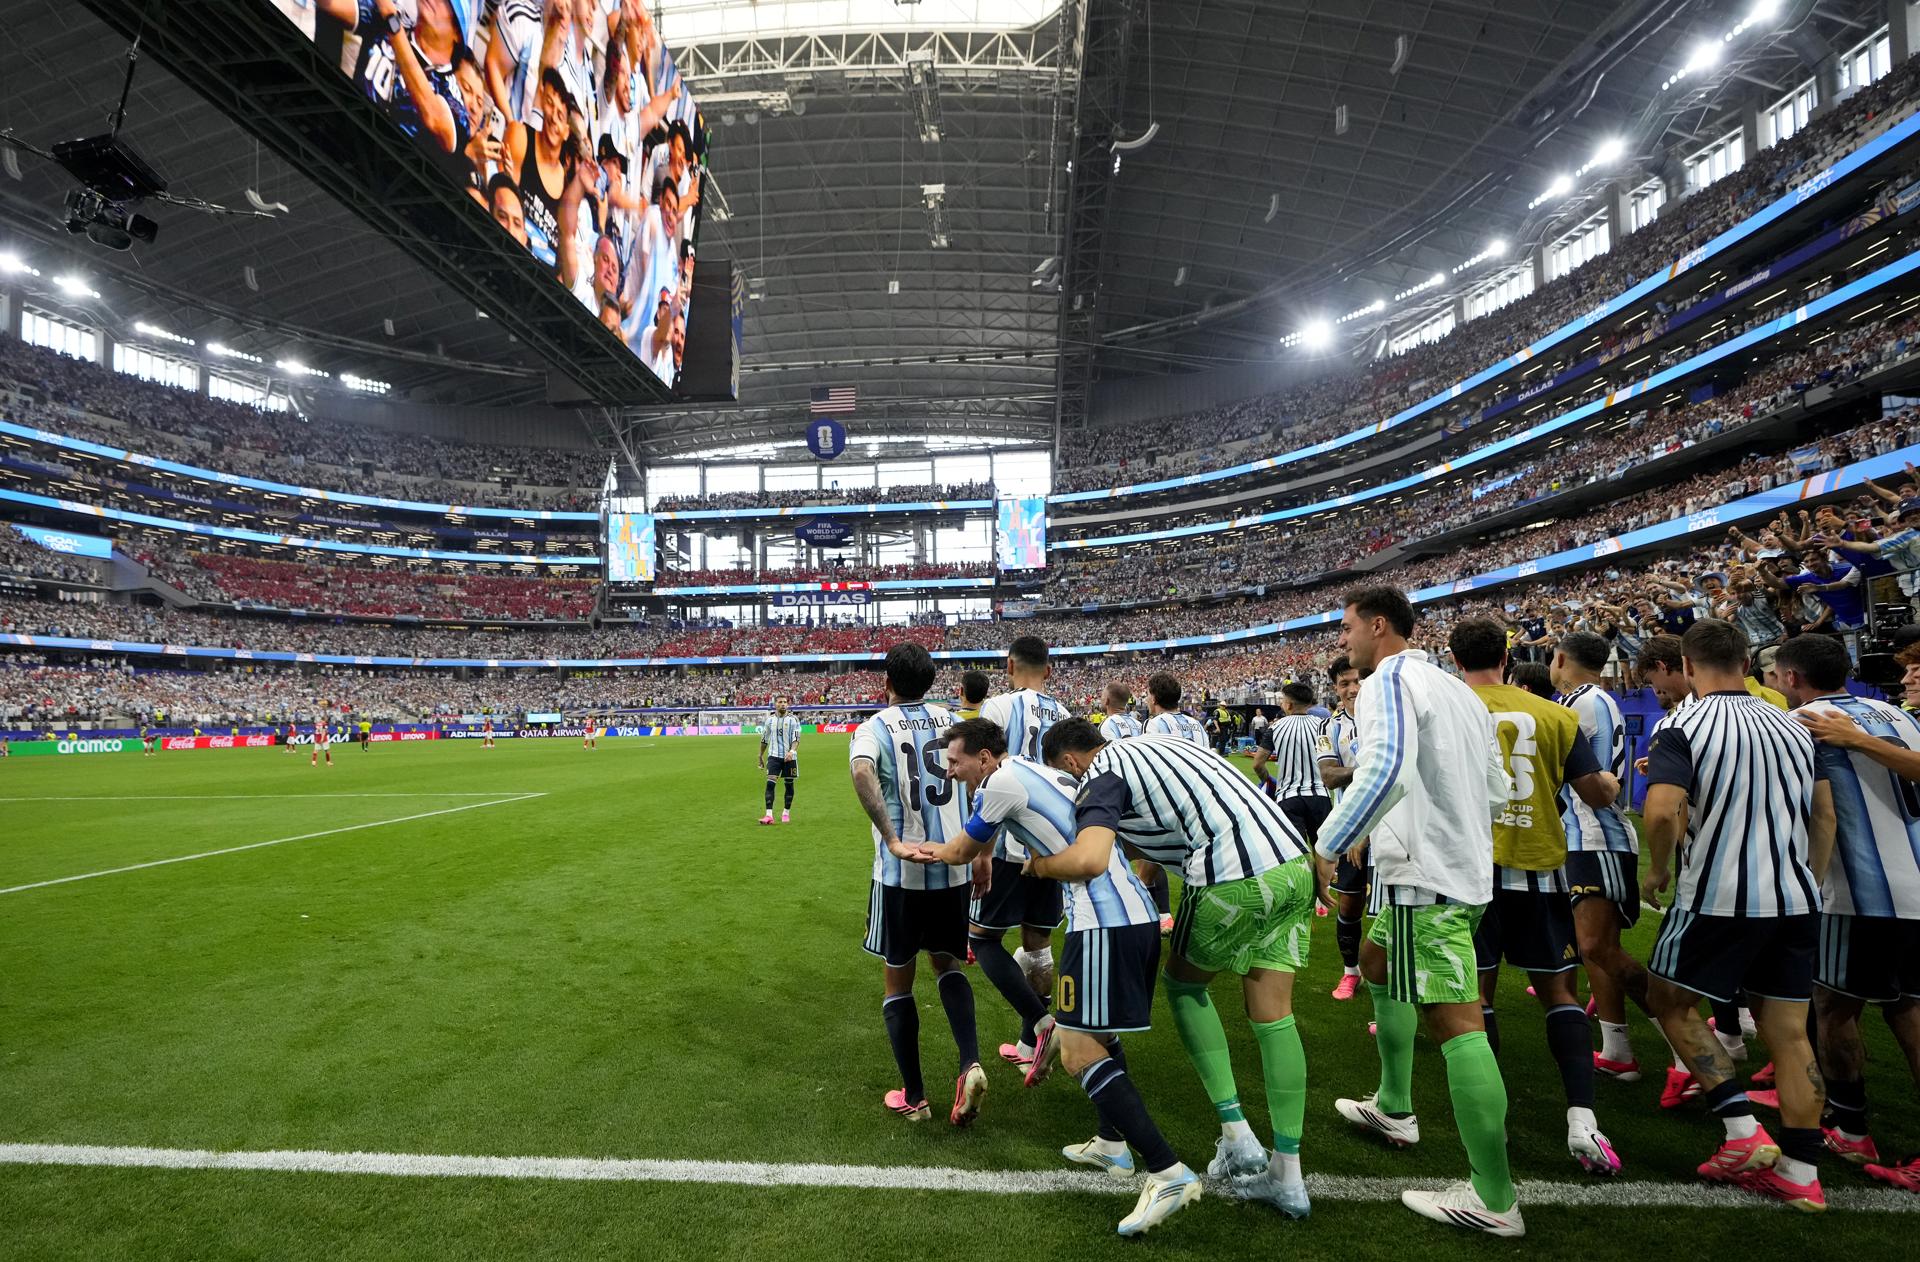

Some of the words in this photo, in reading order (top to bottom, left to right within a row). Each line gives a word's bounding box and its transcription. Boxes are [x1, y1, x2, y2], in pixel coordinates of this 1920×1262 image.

[1518, 379, 1554, 401] DALLAS
[173, 492, 212, 505] DALLAS
[327, 517, 346, 525] WORLD
[1688, 515, 1720, 532] GOAL
[43, 535, 82, 547] GOAL
[782, 593, 866, 606] DALLAS
[1861, 709, 1901, 725] PAUL
[371, 733, 392, 741] Lenovo
[401, 732, 426, 740] Lenovo
[519, 729, 549, 738] QATAR
[552, 729, 587, 737] AIRWAYS
[617, 727, 640, 736] VISA
[57, 739, 123, 754] aramco
[1512, 804, 1534, 813] CUP
[1057, 974, 1075, 1012] 0
